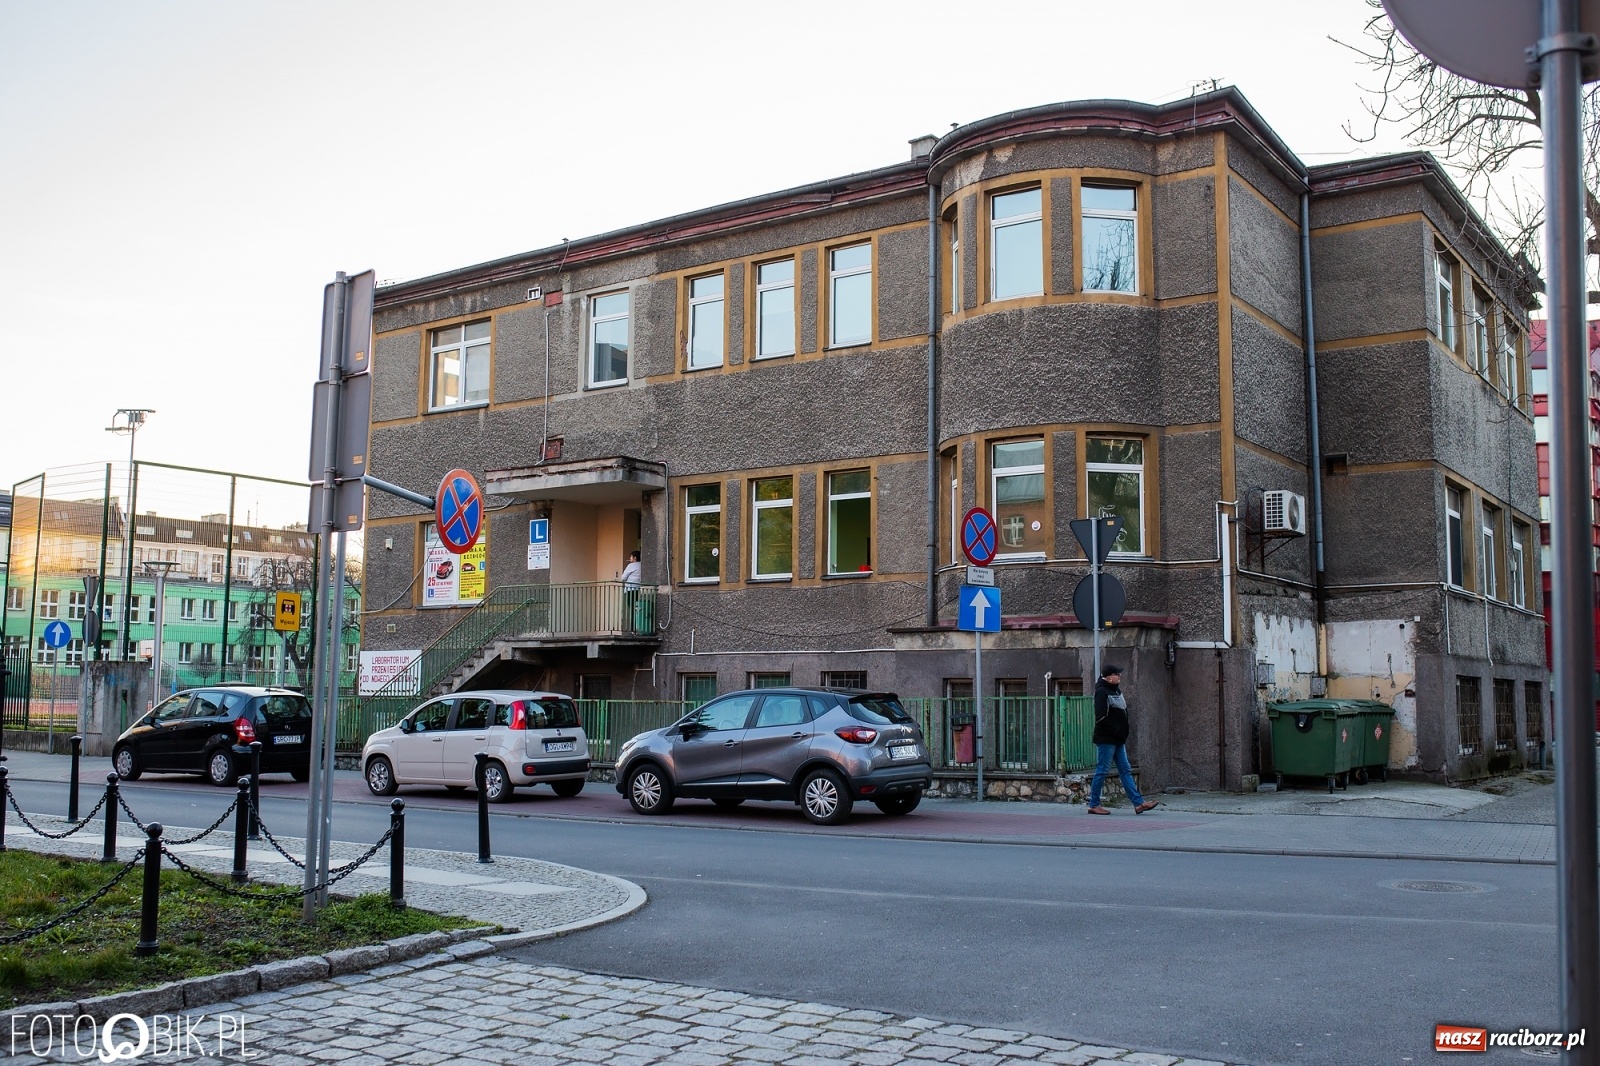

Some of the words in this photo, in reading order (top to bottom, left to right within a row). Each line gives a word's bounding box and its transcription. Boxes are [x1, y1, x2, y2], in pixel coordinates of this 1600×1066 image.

[536, 524, 544, 540] L
[428, 577, 436, 586] 25
[372, 656, 410, 664] LABORATORIUM
